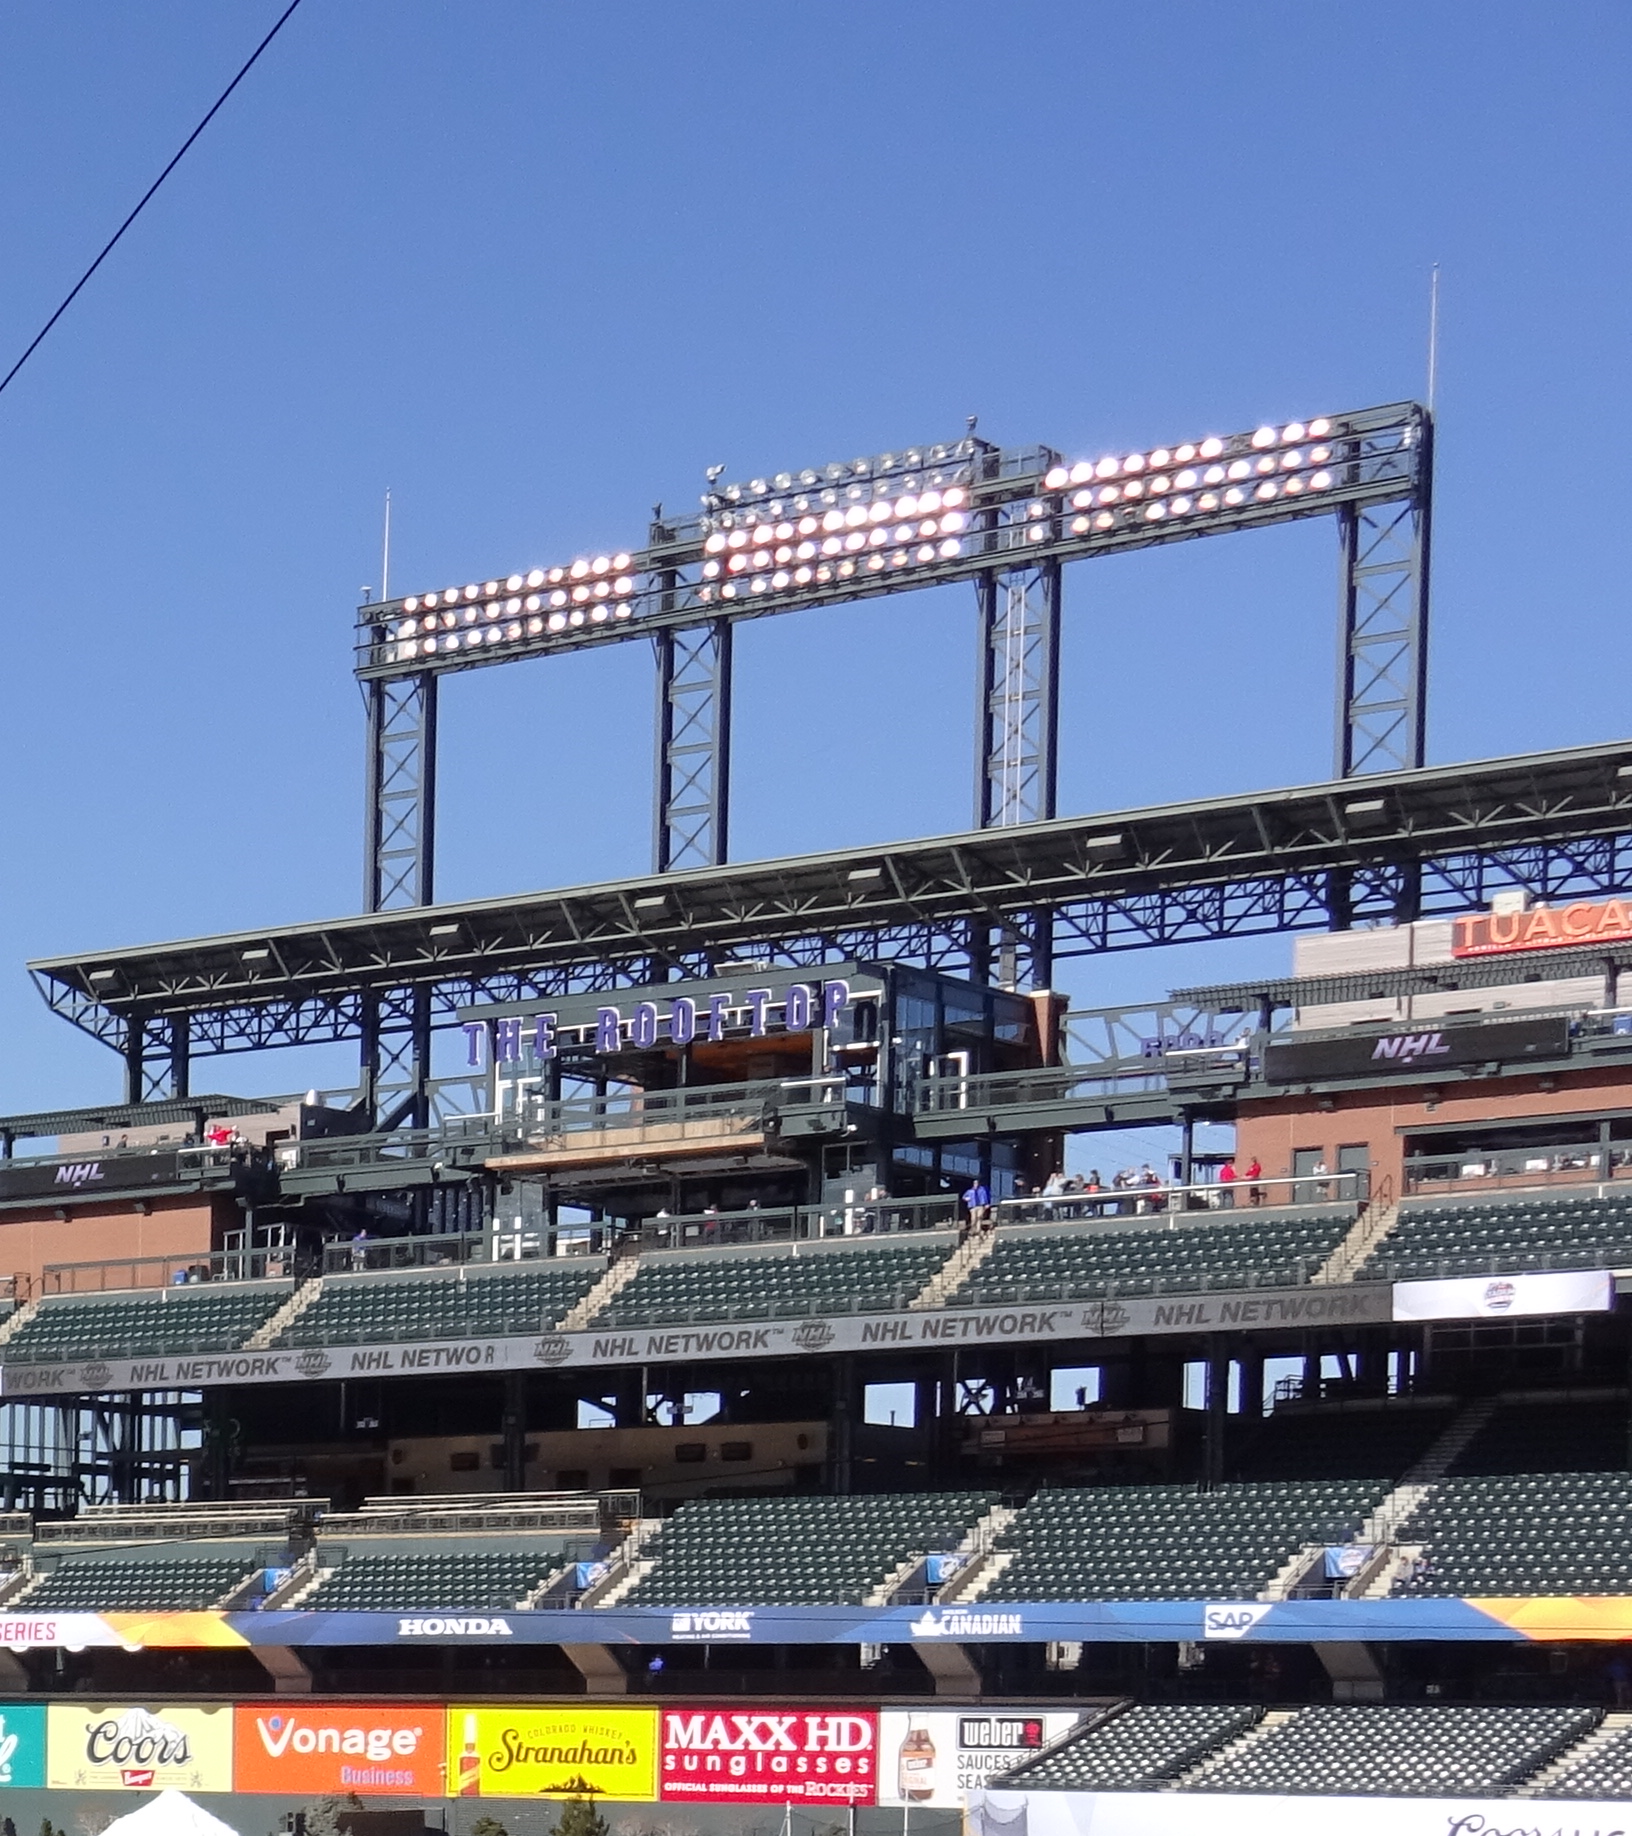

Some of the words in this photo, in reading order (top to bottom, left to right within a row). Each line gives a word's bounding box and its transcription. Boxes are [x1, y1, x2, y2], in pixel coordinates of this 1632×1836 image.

[1456, 896, 1632, 948] TUACA
[462, 1013, 558, 1066] THE
[596, 981, 850, 1055] ROOFTOP
[1372, 1033, 1450, 1060] NHL
[54, 1162, 105, 1184] NHL
[1154, 1304, 1212, 1327] NHL
[862, 1320, 913, 1343] NHL
[592, 1338, 638, 1359] NHL
[130, 1364, 170, 1383] NHL
[350, 1352, 396, 1372] NHL
[397, 1617, 513, 1636] HONDA
[692, 1611, 752, 1631] YORK
[940, 1613, 1022, 1636] CANADIAN
[1208, 1612, 1254, 1631] SAP
[86, 1719, 192, 1764] Coors
[256, 1717, 420, 1762] Vonage
[527, 1723, 577, 1740] COLORADO
[582, 1724, 623, 1740] WHISKEY
[665, 1716, 797, 1751] MAXX
[963, 1718, 1024, 1747] weber
[488, 1728, 638, 1772] Stranahan's
[664, 1752, 869, 1775] sunglasses
[957, 1755, 1010, 1770] SAUCES
[341, 1765, 414, 1785] Business
[664, 1783, 707, 1793] OFFICIAL
[709, 1783, 769, 1794] SUNGLASSES
[771, 1783, 784, 1793] OF
[786, 1784, 804, 1794] THE
